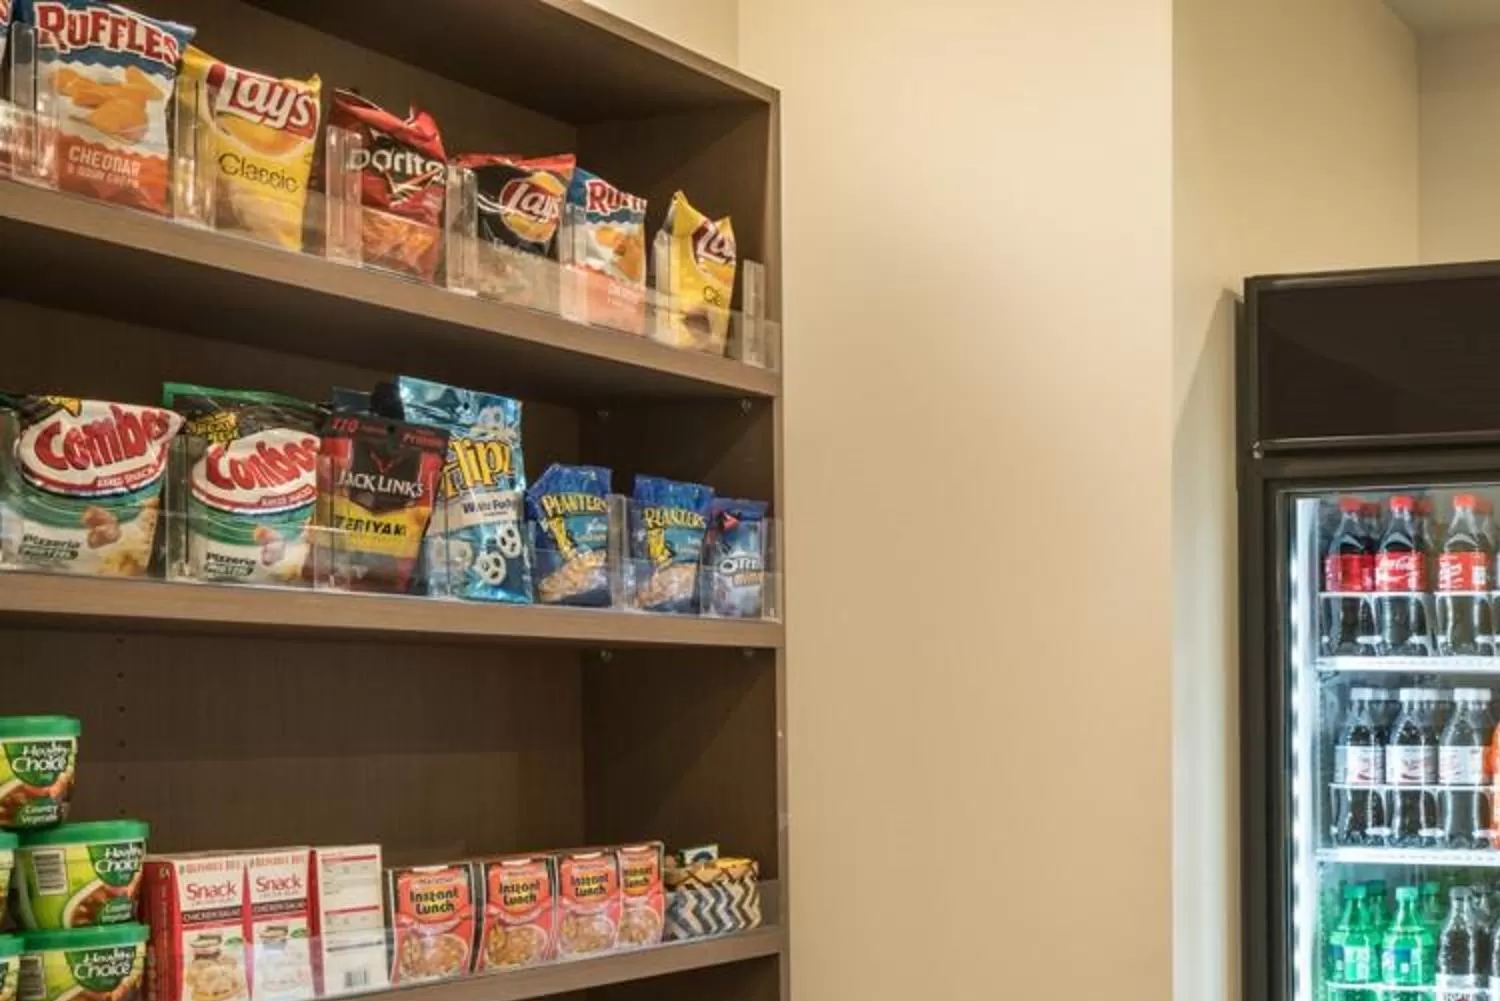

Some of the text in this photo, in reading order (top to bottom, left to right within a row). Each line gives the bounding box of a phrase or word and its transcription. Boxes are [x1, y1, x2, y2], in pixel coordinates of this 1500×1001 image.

[34, 1, 183, 67] RUFFLES
[218, 152, 299, 194] Classic
[34, 403, 171, 471] Combos
[186, 880, 238, 900] Snack
[255, 872, 304, 892] Snack
